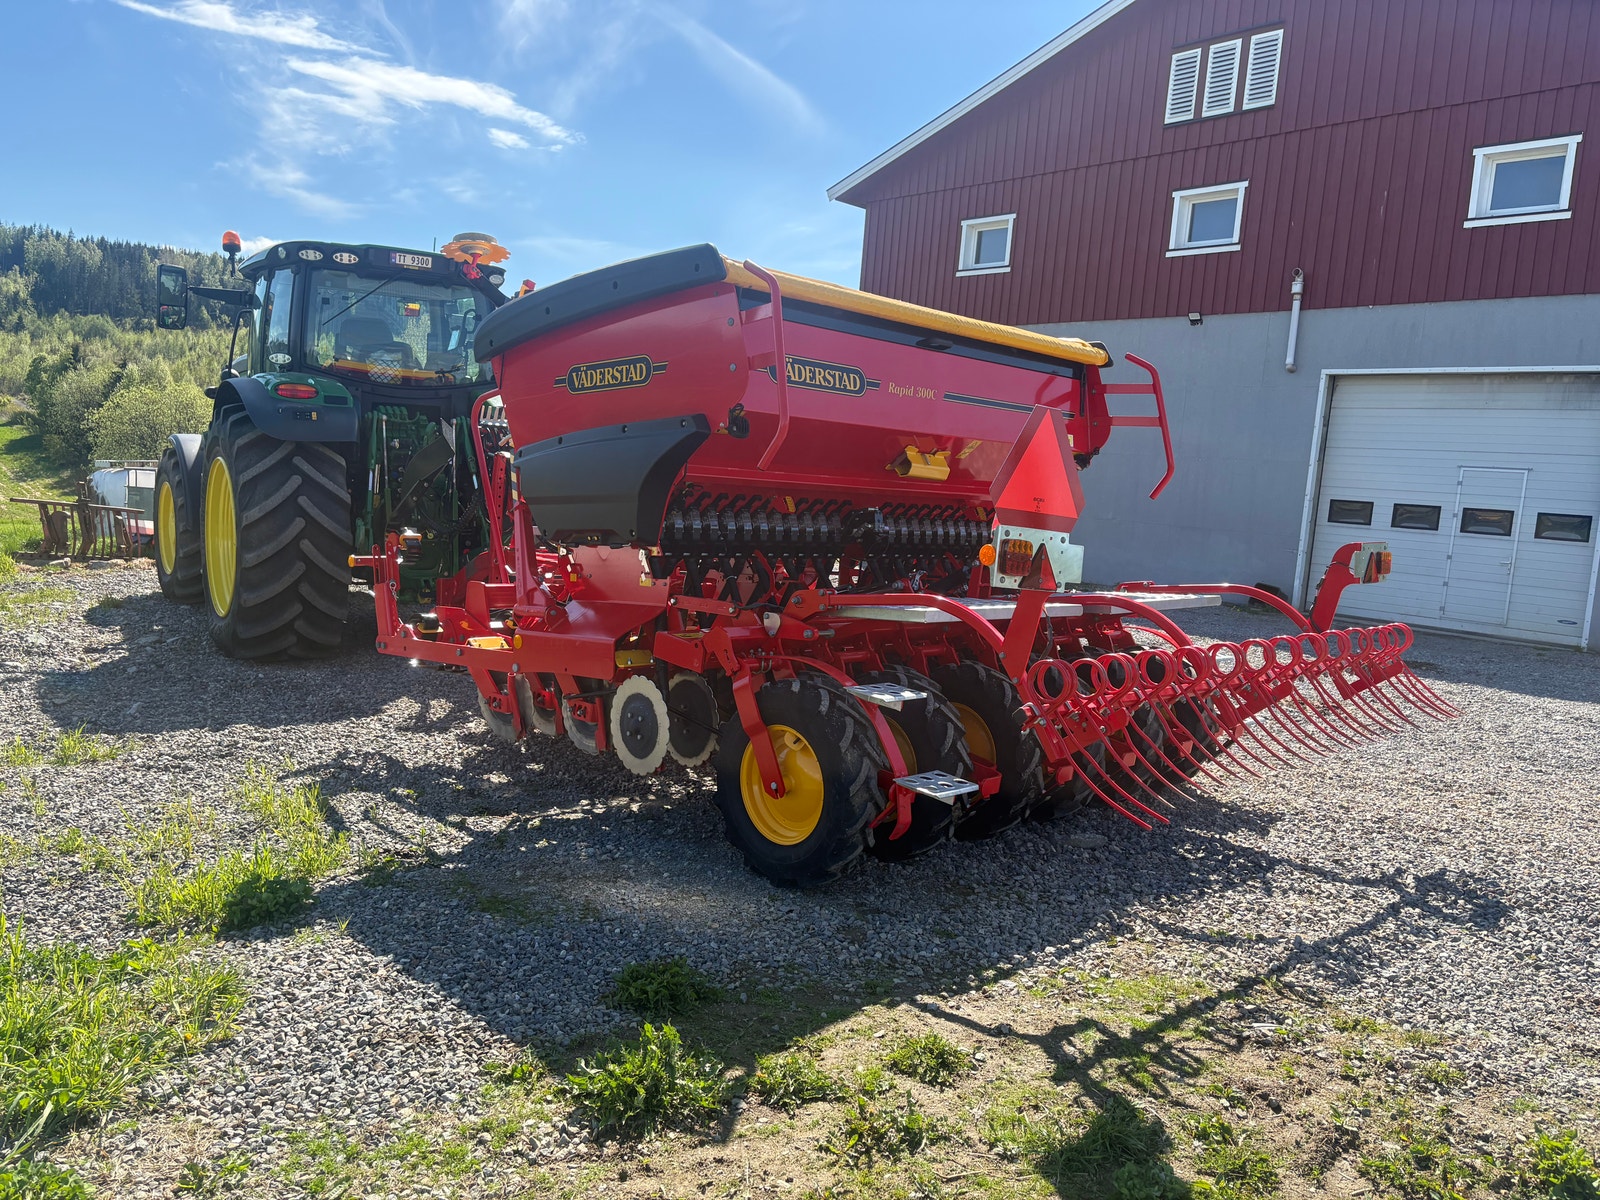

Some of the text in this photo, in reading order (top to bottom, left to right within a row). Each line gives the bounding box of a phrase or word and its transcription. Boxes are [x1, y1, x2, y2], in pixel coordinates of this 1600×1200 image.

[398, 254, 430, 267] TT 9300
[572, 363, 647, 389] VÄDERSTAD
[785, 357, 861, 391] ÄDERSTAD
[888, 382, 938, 400] Rapid 300C
